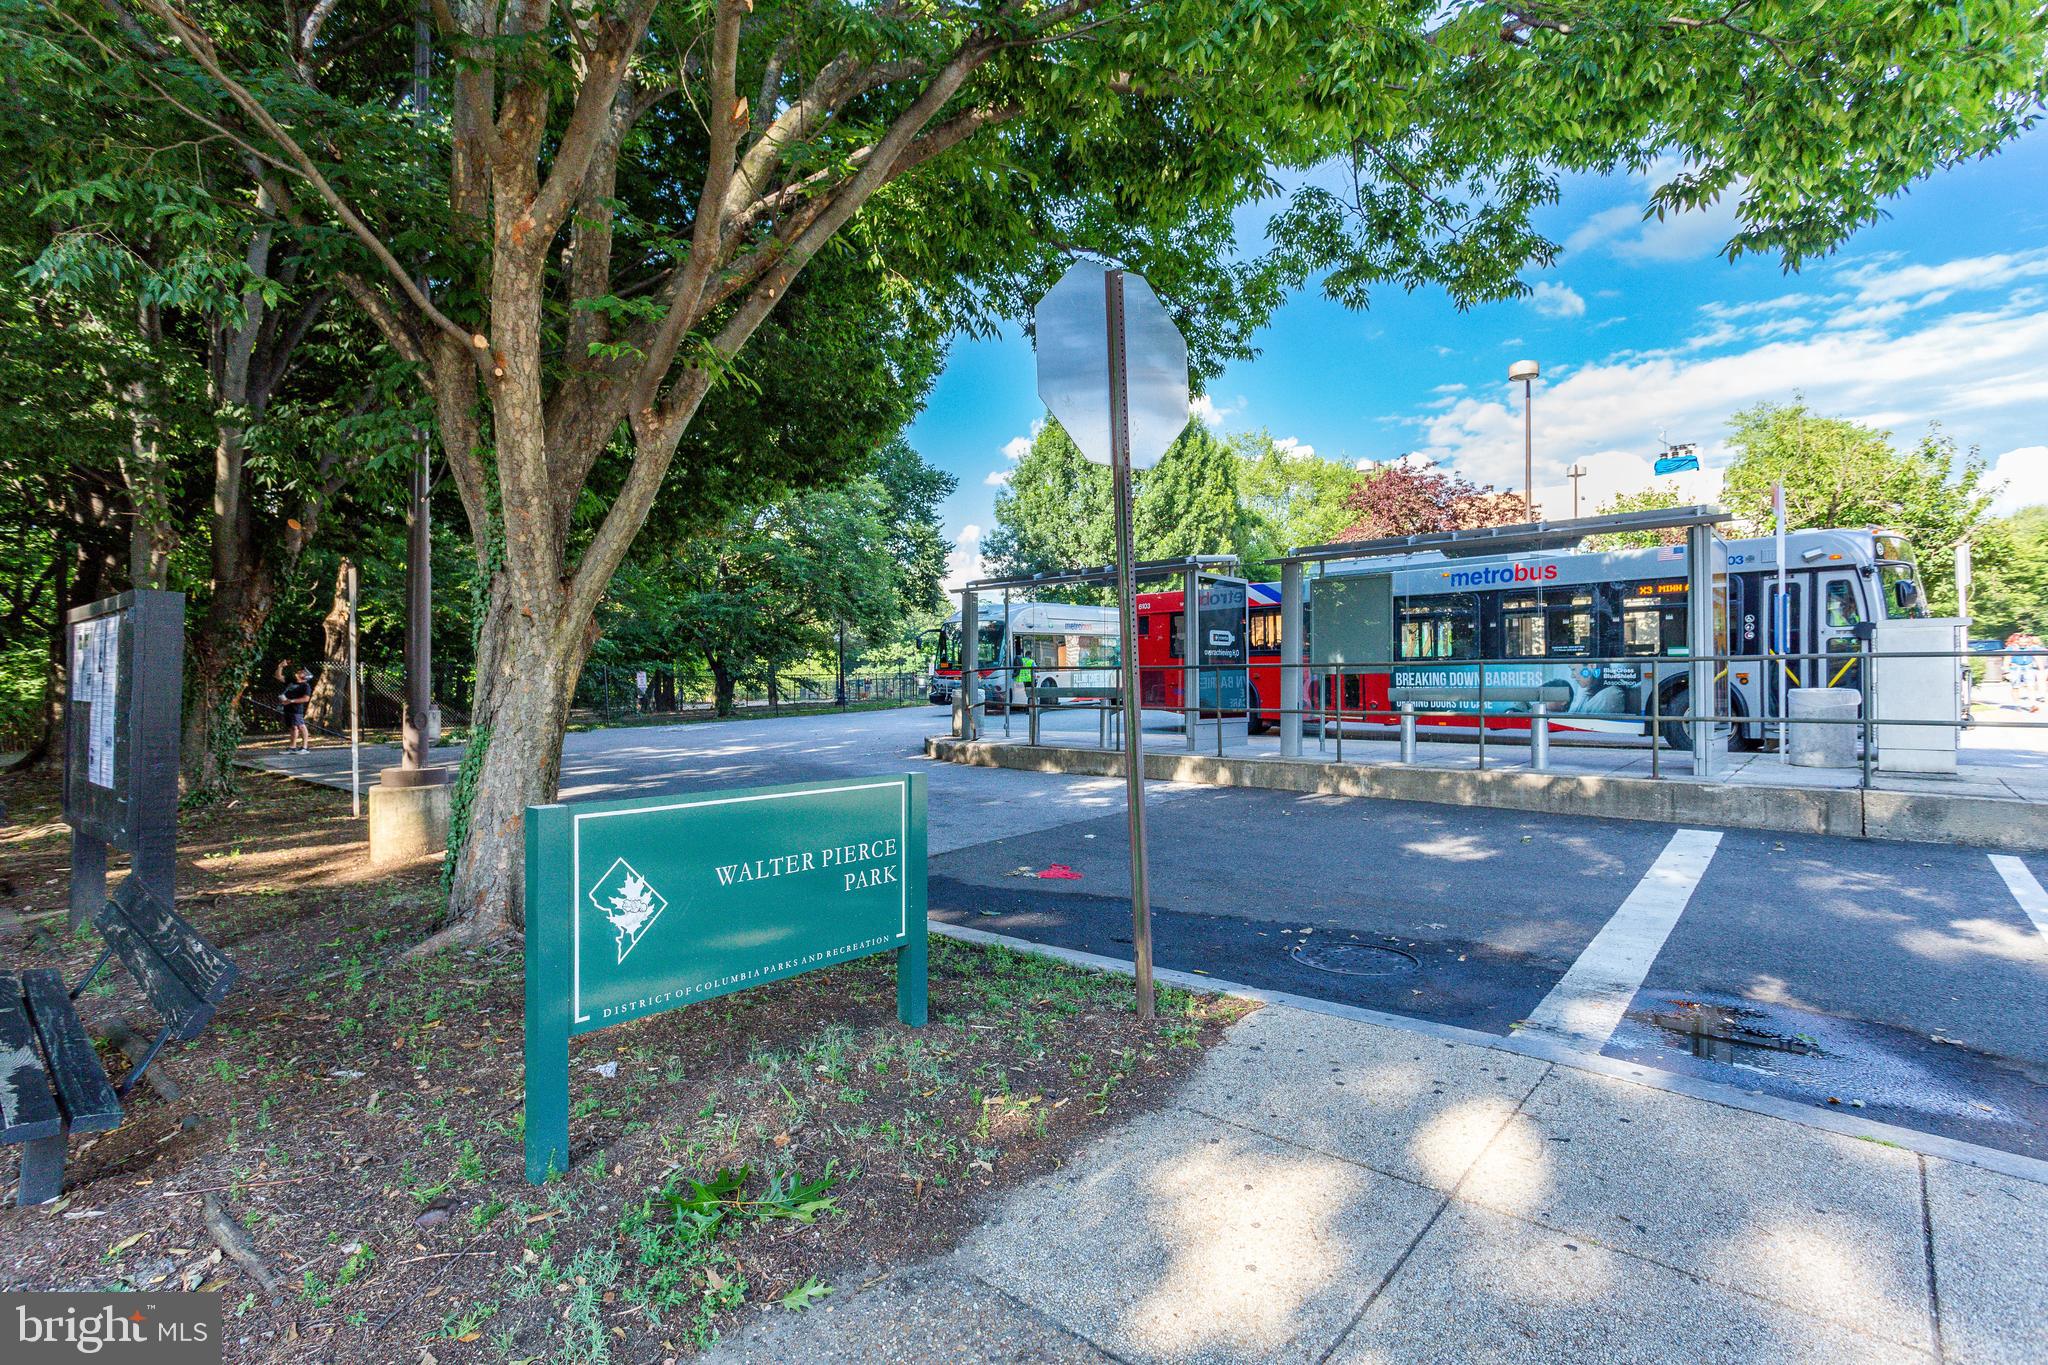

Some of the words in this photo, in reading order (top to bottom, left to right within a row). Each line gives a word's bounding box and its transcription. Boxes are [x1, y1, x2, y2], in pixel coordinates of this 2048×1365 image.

[1450, 563, 1558, 587] metrobus
[1639, 585, 1653, 595] X3
[1395, 671, 1447, 686] BREAKING
[1450, 671, 1480, 686] DOWN
[1485, 671, 1543, 687] BARRIERS
[715, 852, 815, 887] WALTER
[822, 838, 897, 868] PIERCE
[844, 864, 898, 892] PARK
[603, 991, 672, 1018] DISTRICT
[675, 986, 693, 998] OF
[695, 969, 760, 993] COLUMBIA
[763, 958, 799, 975] PARKS
[801, 952, 823, 965] AND
[826, 935, 890, 958] RECREATION
